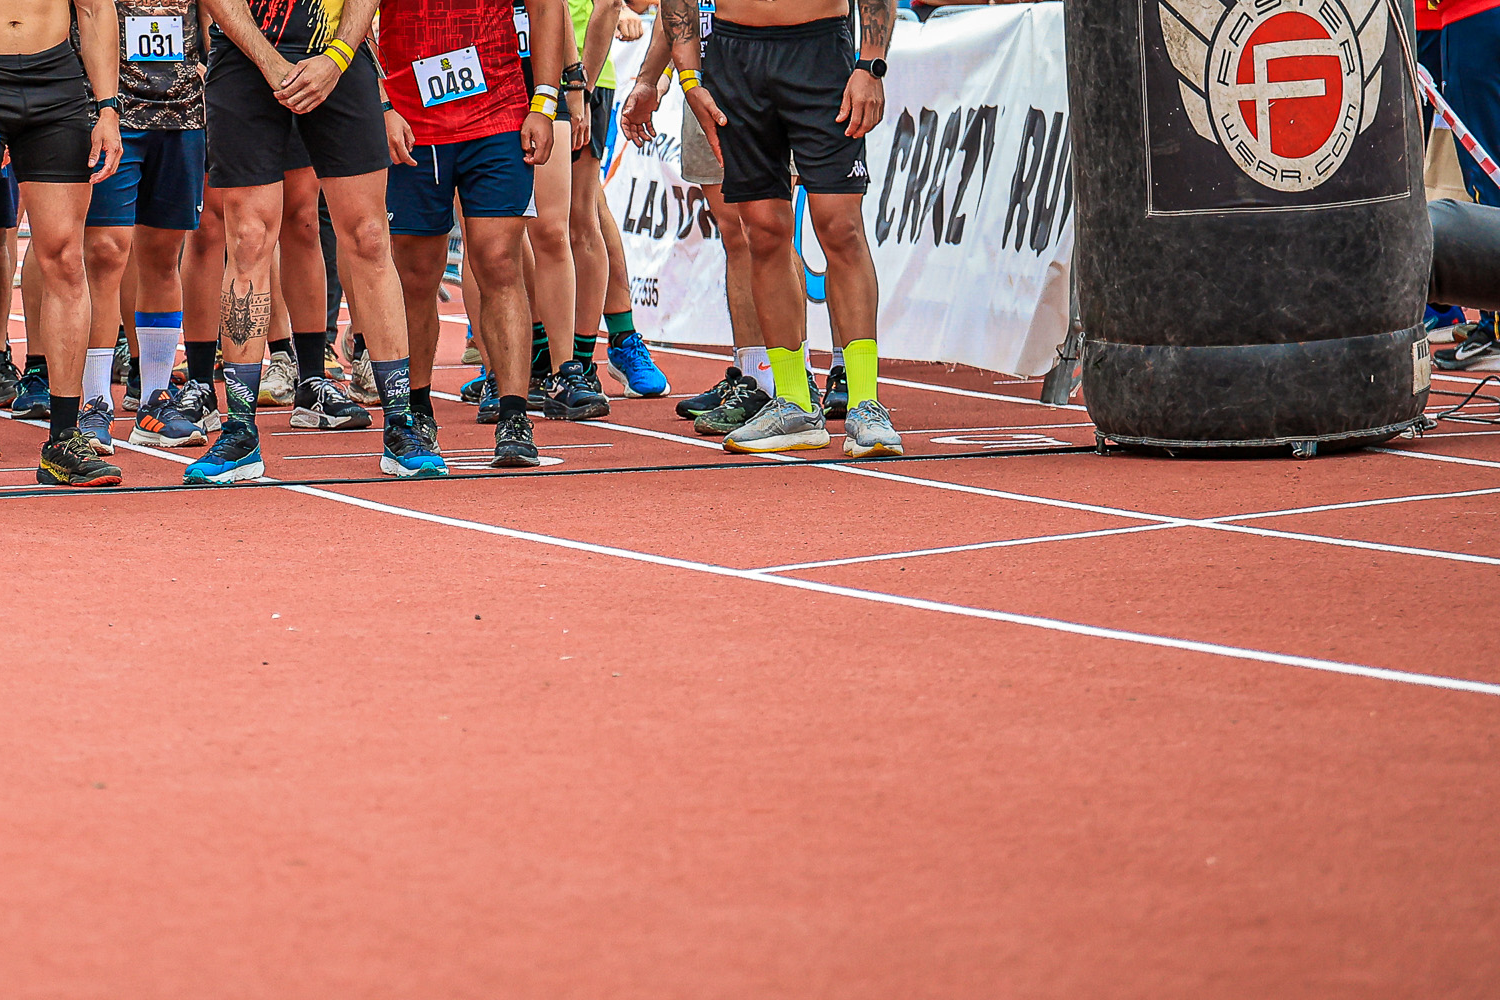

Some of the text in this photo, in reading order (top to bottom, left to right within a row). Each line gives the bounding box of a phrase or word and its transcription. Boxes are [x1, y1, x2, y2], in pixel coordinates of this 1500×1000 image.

[138, 33, 174, 58] 031
[428, 66, 476, 101] 048
[1220, 102, 1357, 184] WEAR.COM
[1002, 104, 1074, 258] RU
